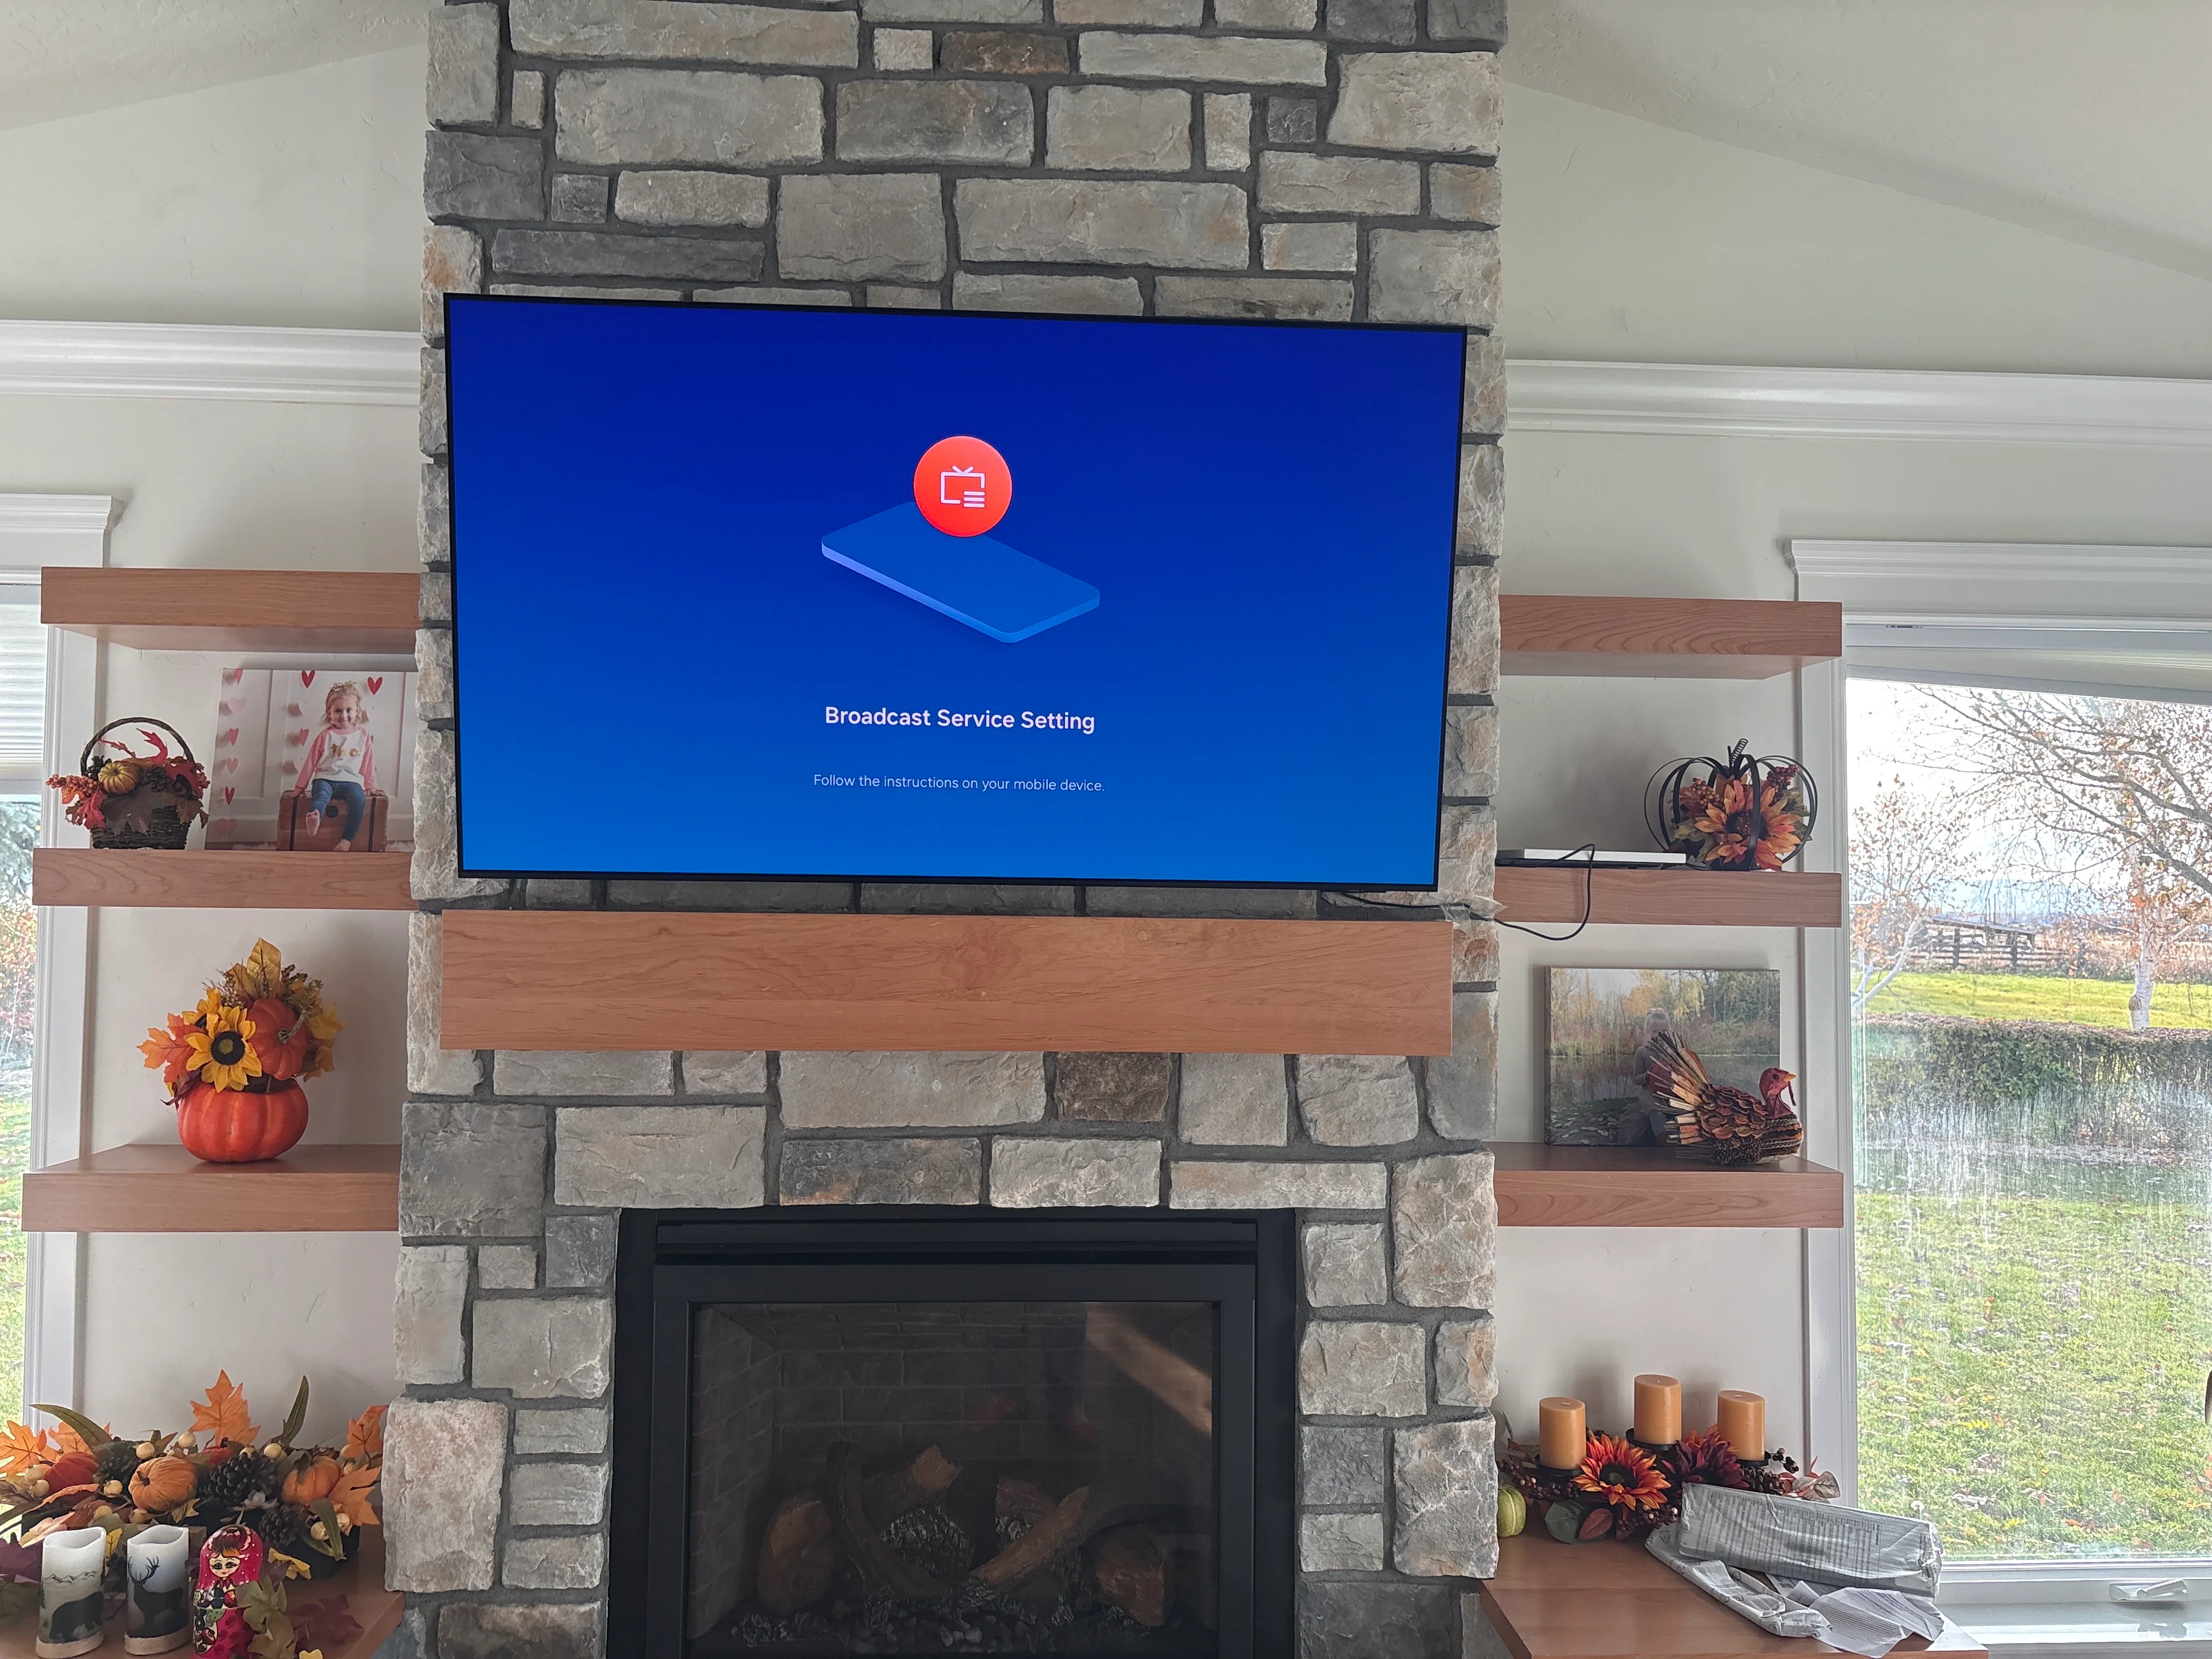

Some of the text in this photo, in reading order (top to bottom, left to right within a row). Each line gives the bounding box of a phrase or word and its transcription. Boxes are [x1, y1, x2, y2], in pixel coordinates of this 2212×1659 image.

[825, 706, 1094, 735] Broadcast Service Setting
[814, 774, 1104, 792] Follow the instructions on your mobile device.
